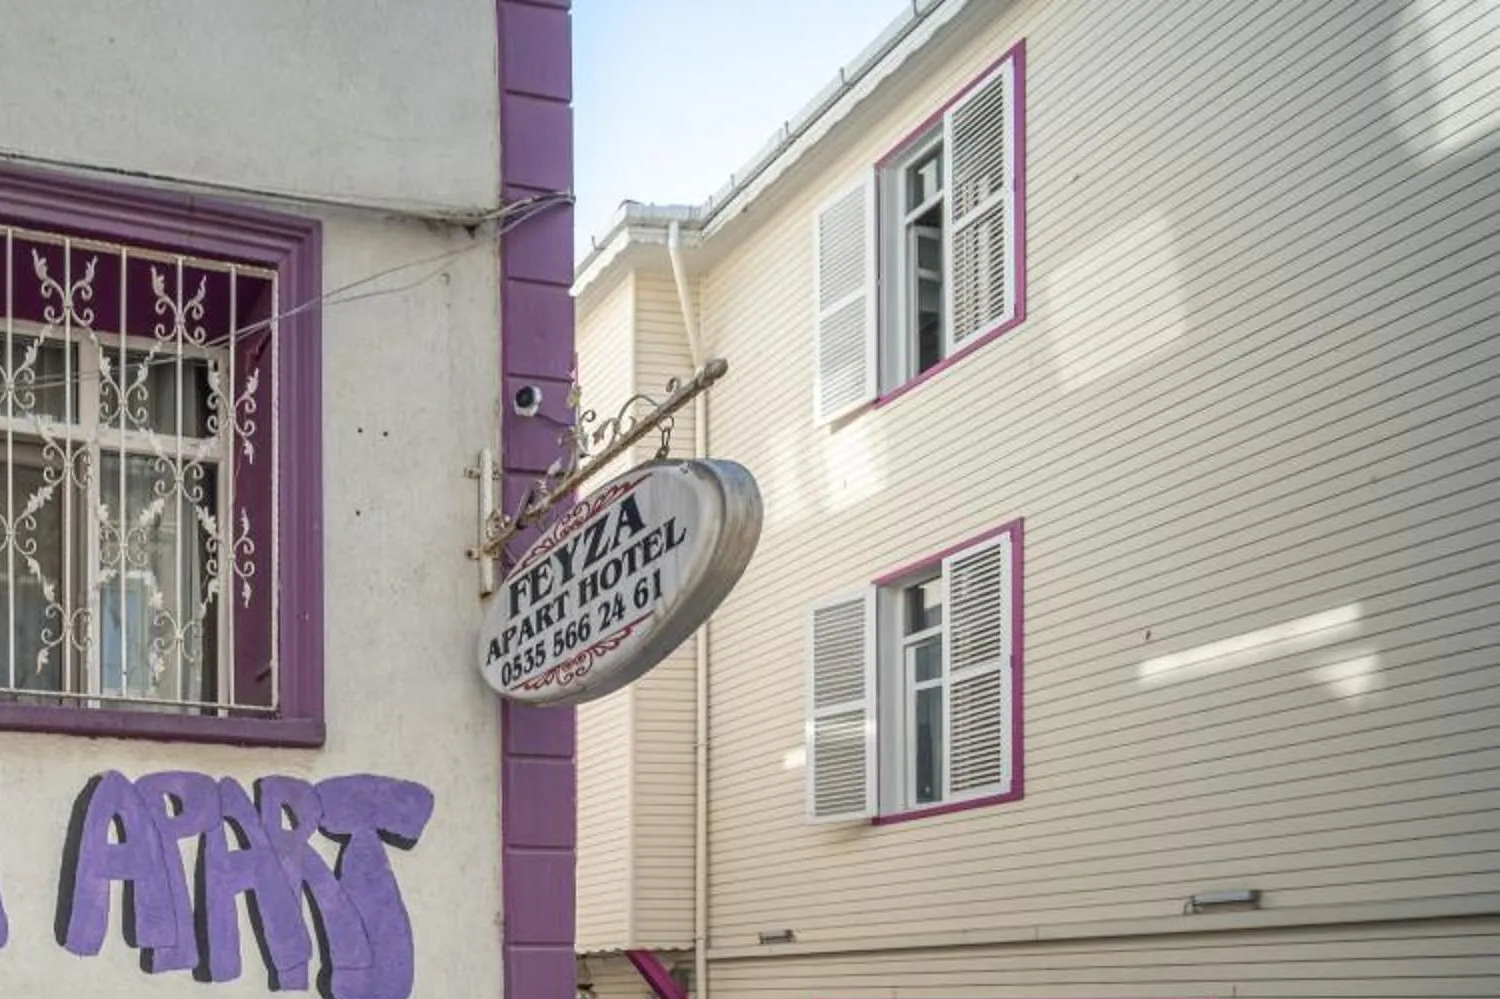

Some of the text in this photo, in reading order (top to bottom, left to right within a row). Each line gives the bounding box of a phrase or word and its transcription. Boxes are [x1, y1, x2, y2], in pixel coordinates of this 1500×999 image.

[486, 516, 687, 665] APART HOTEL
[509, 494, 645, 619] FEYZA
[501, 568, 663, 686] 0535 566 24 61
